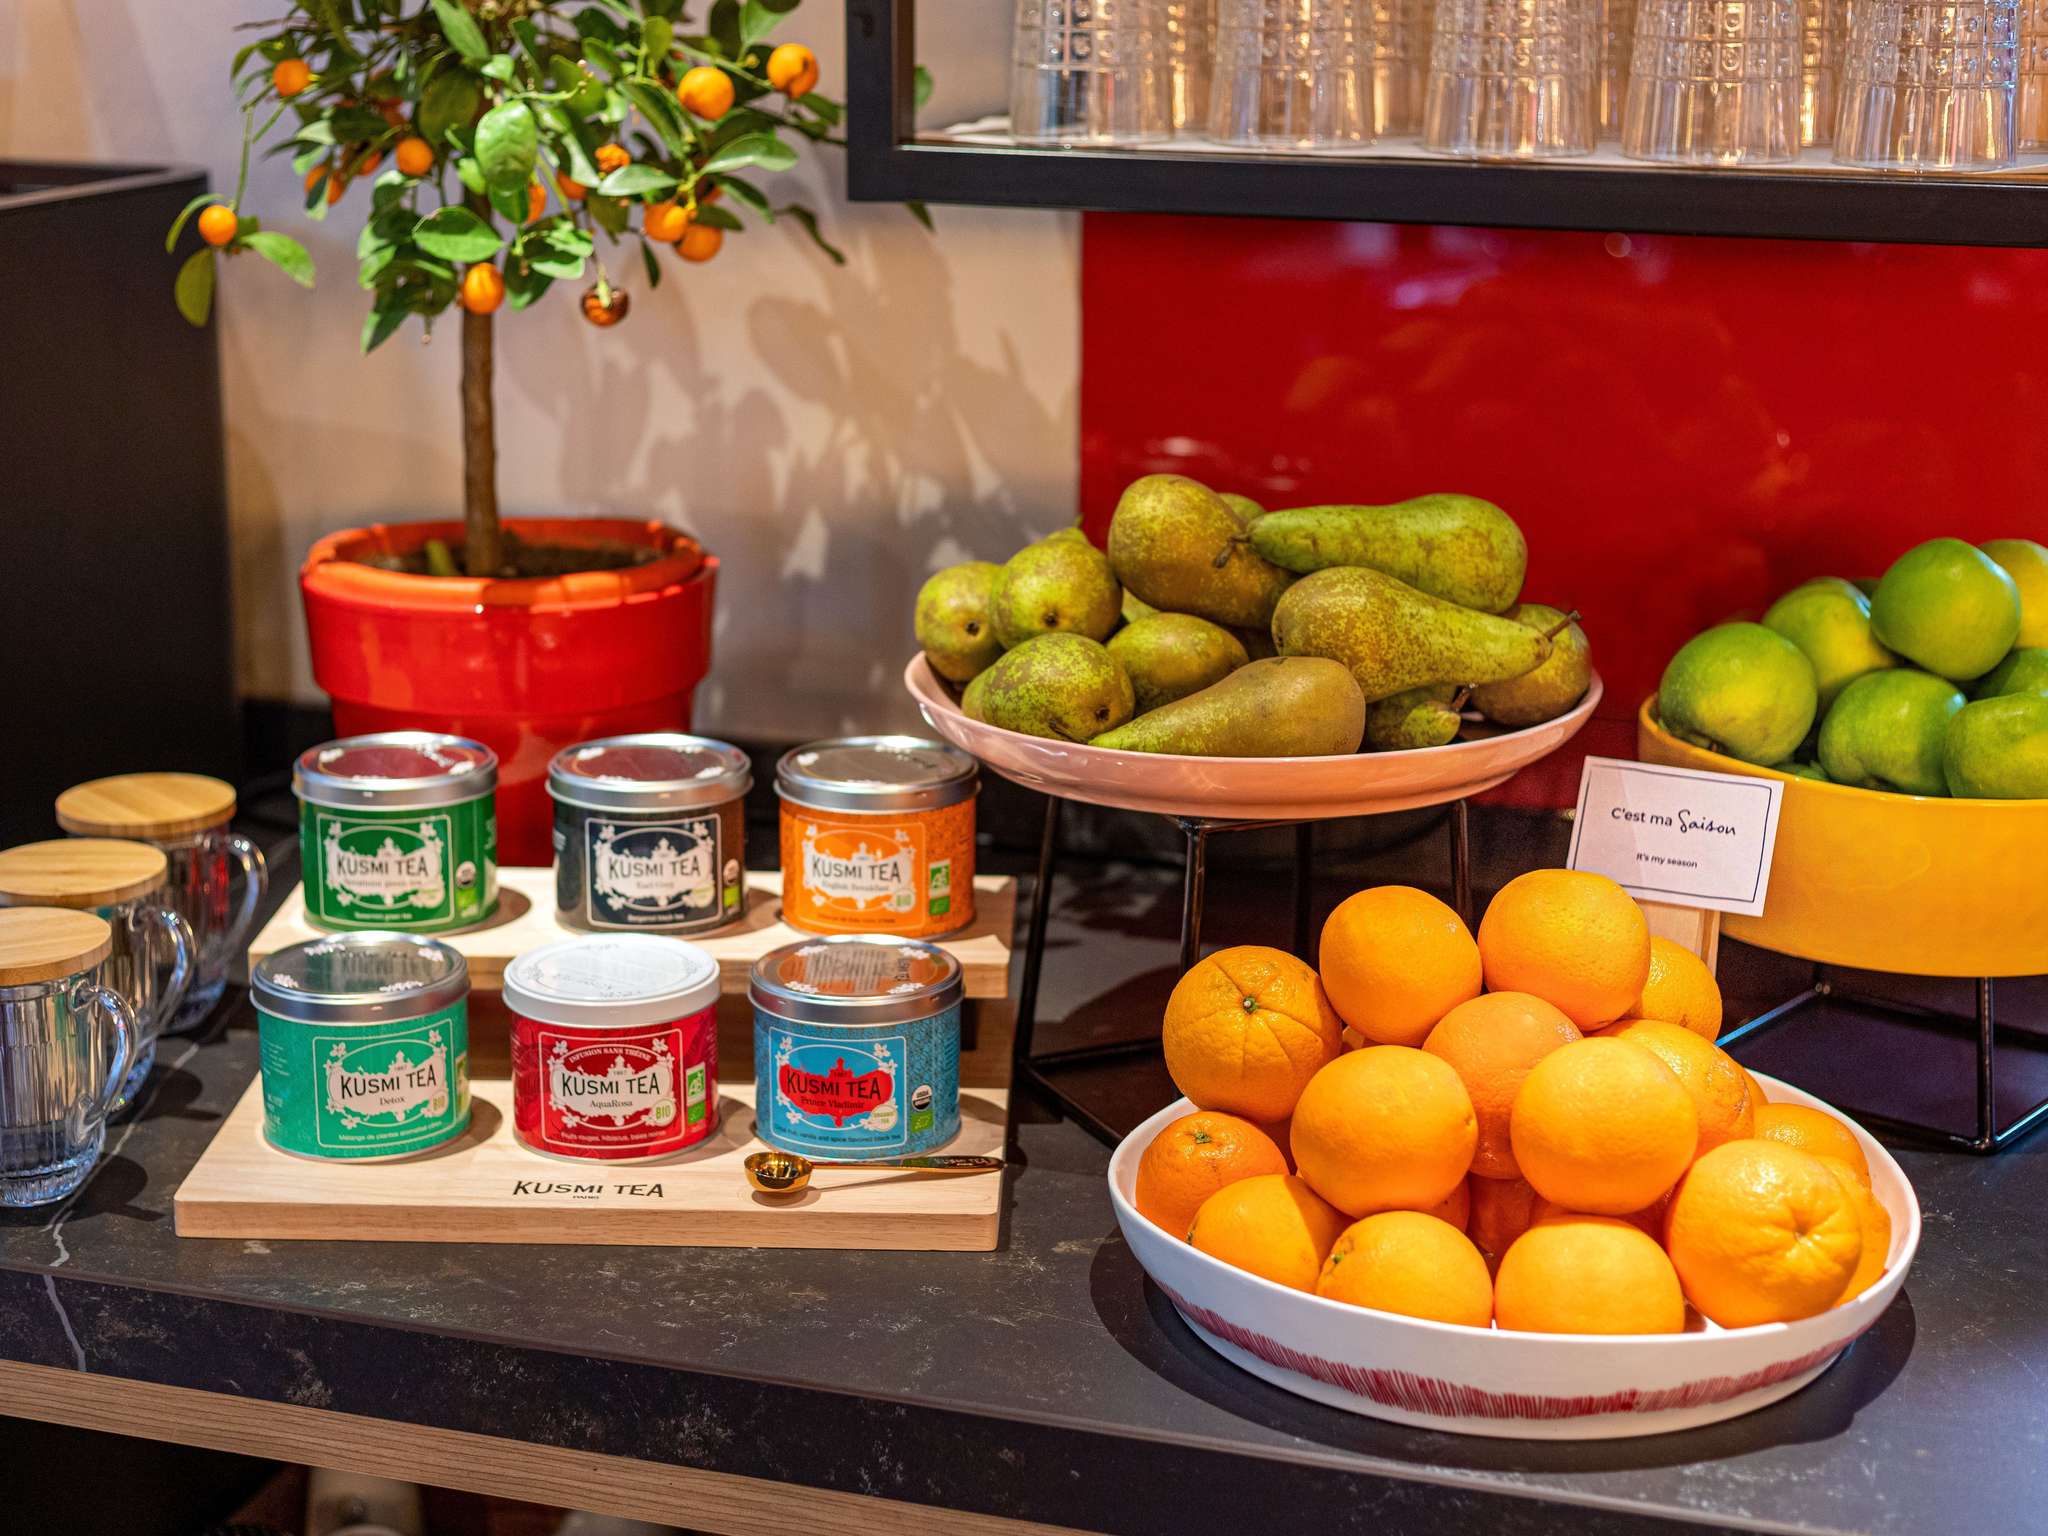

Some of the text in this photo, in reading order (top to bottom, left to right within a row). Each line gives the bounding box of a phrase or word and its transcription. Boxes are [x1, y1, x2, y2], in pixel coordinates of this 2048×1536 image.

[1611, 807, 1736, 836] C'est ma Saison
[337, 855, 429, 877] KUSMI TEA
[608, 854, 701, 879] KUSMI TEA
[812, 856, 901, 883] KUSMI TEA
[1636, 853, 1698, 869] It's my season
[568, 1047, 602, 1064] INFUSION
[602, 1047, 624, 1055] SANS
[340, 1064, 437, 1100] KUSMI TEA
[562, 1073, 660, 1097] KUSMI TEA
[787, 1070, 881, 1100] KUSMI TEA
[380, 1096, 406, 1106] Detox
[590, 1099, 633, 1109] AquaRosa
[655, 1105, 671, 1120] BIO
[513, 1180, 664, 1198] KUSMI TEA
